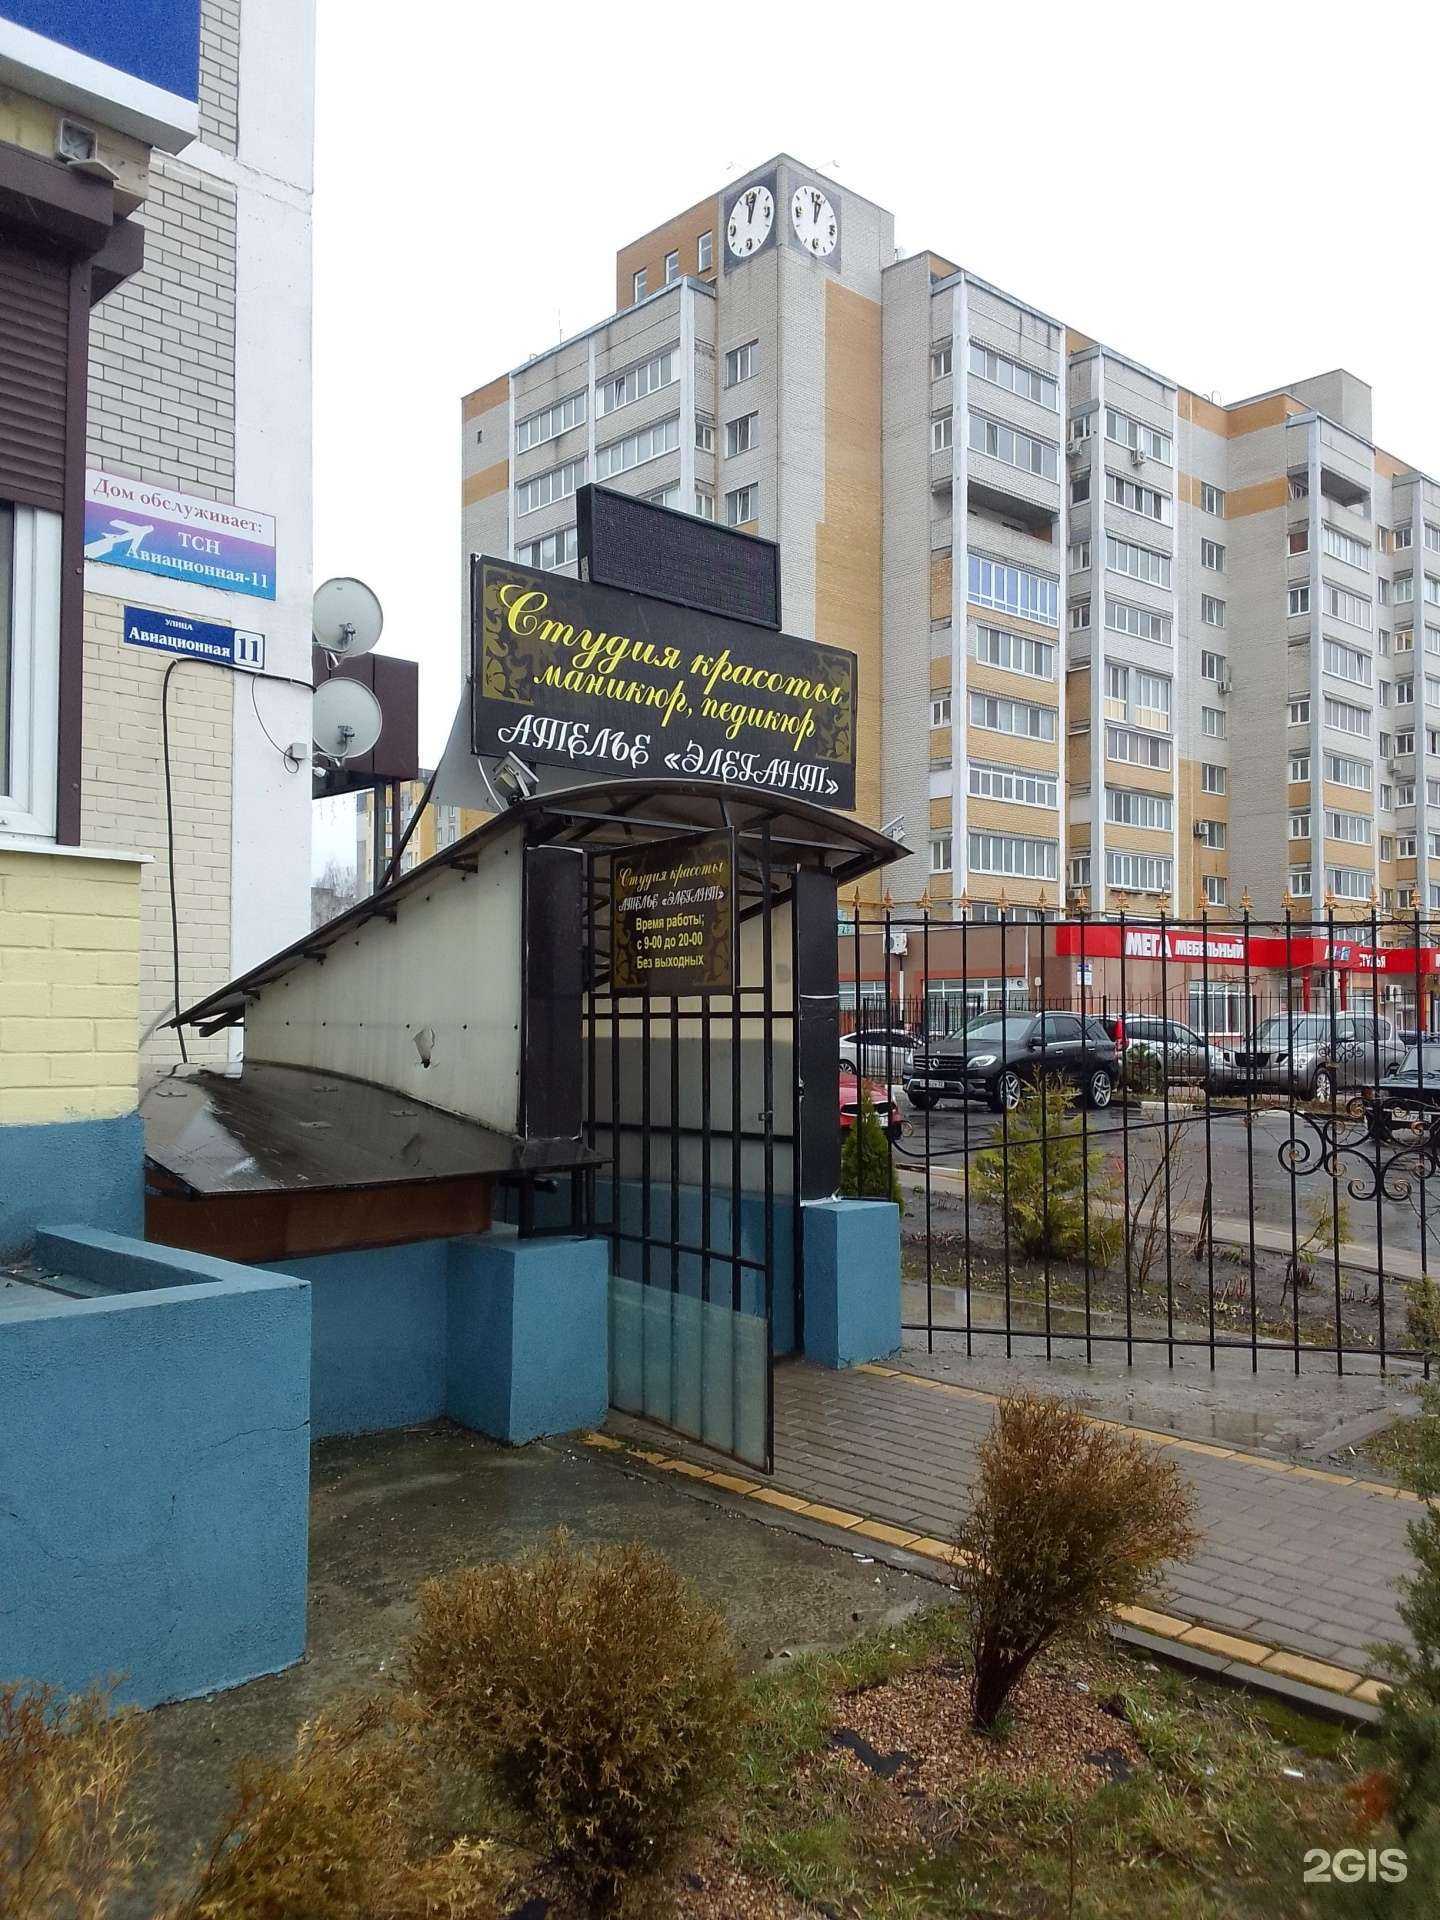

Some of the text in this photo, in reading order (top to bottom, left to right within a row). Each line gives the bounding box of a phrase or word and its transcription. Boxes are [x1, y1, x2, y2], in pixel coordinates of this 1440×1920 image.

[93, 478, 263, 533] Дом обслуживает:
[177, 531, 221, 556] ТСН
[126, 544, 269, 589] Авиационная-11
[129, 626, 231, 657] Авиационная
[238, 637, 260, 662] 11
[499, 584, 843, 705] Студия красоты
[533, 664, 816, 752] маникюр, педикюр
[498, 714, 839, 795] АТЕЛЬЕ «ЭЛЕГАНТ»
[619, 862, 723, 892] Студия красоты
[635, 917, 665, 933] Время
[636, 931, 703, 950] с 9-00 до 20-00
[1125, 932, 1172, 958] МЕГА
[636, 954, 704, 969] Без выходных
